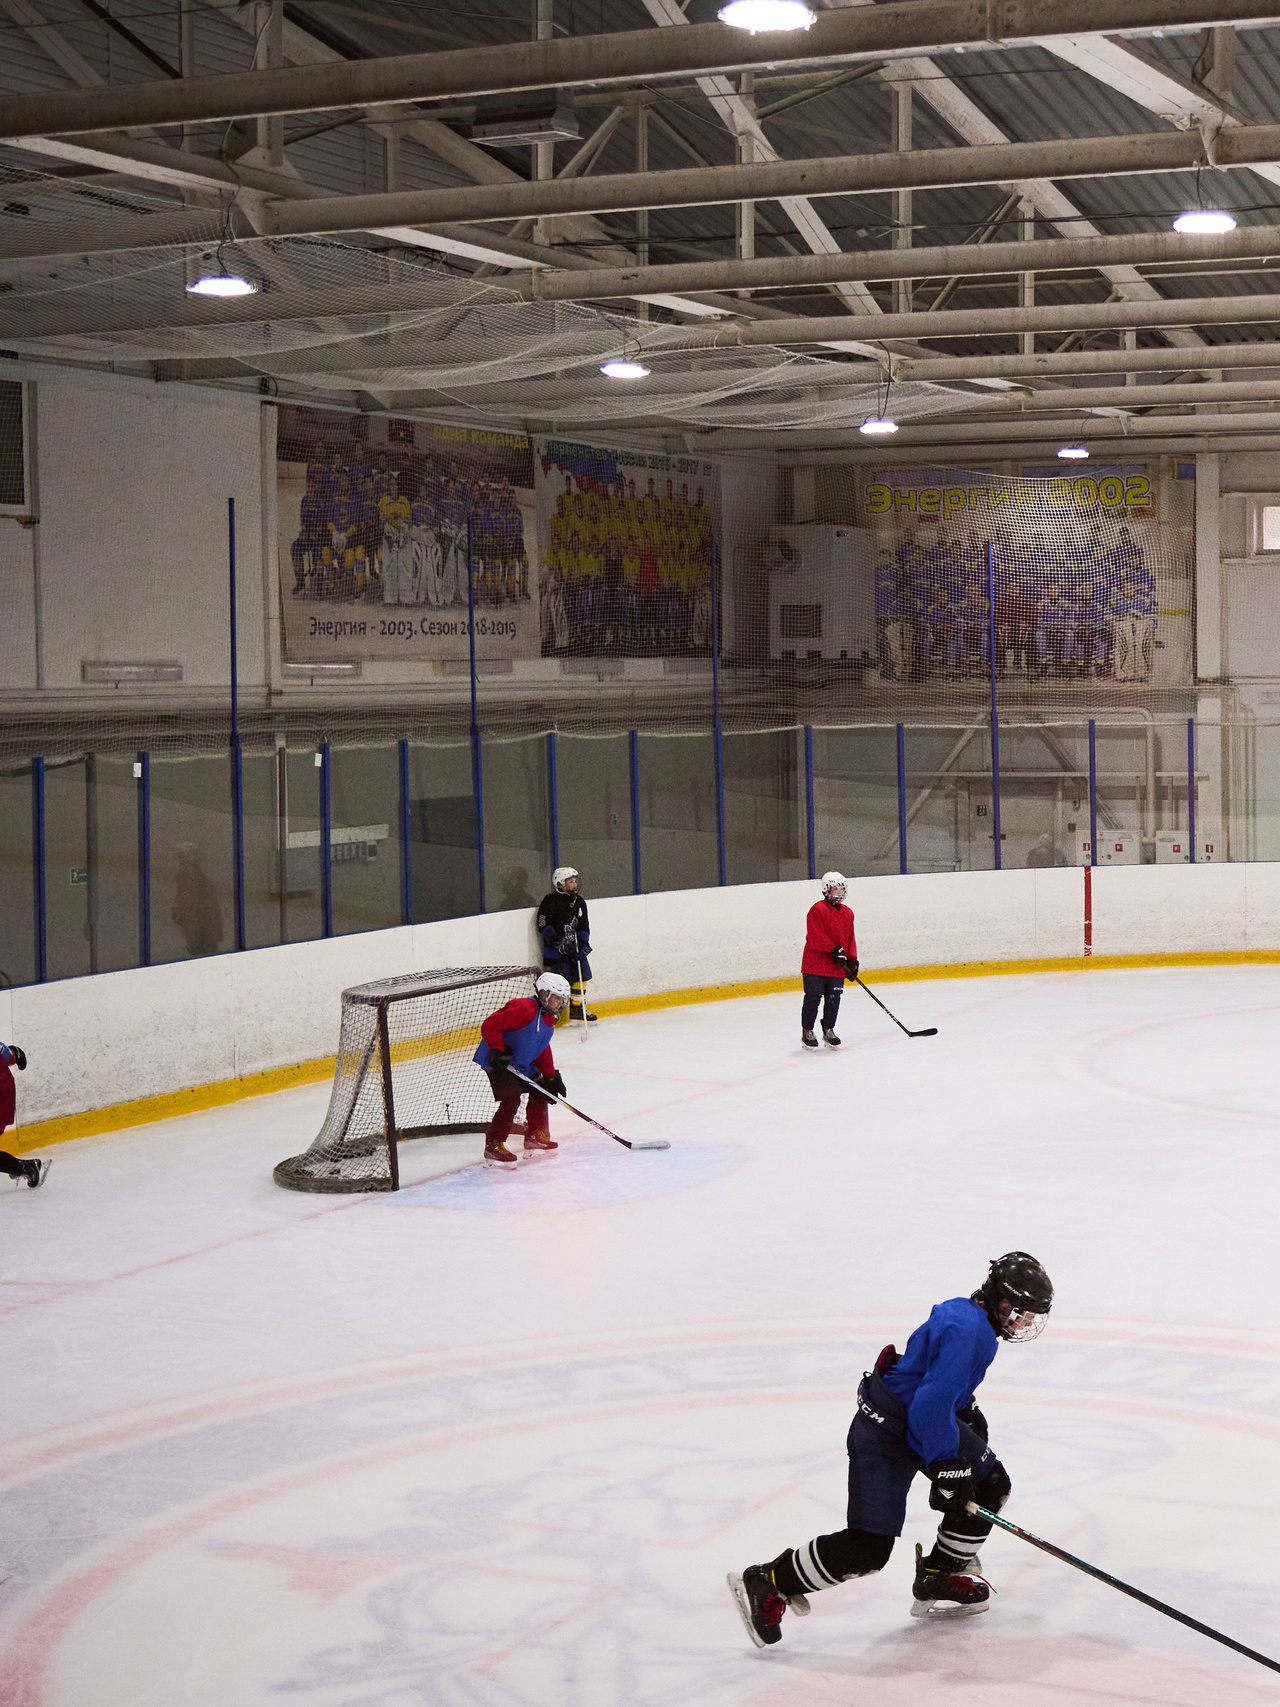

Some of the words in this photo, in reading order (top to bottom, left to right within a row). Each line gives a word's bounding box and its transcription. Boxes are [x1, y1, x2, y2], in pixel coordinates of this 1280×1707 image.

[865, 483, 1035, 521] Энергия
[1050, 476, 1151, 507] 2002
[309, 616, 367, 641] Энергия
[379, 620, 417, 640] 2003.
[420, 617, 458, 636] Сезон
[937, 1467, 972, 1479] PRIME
